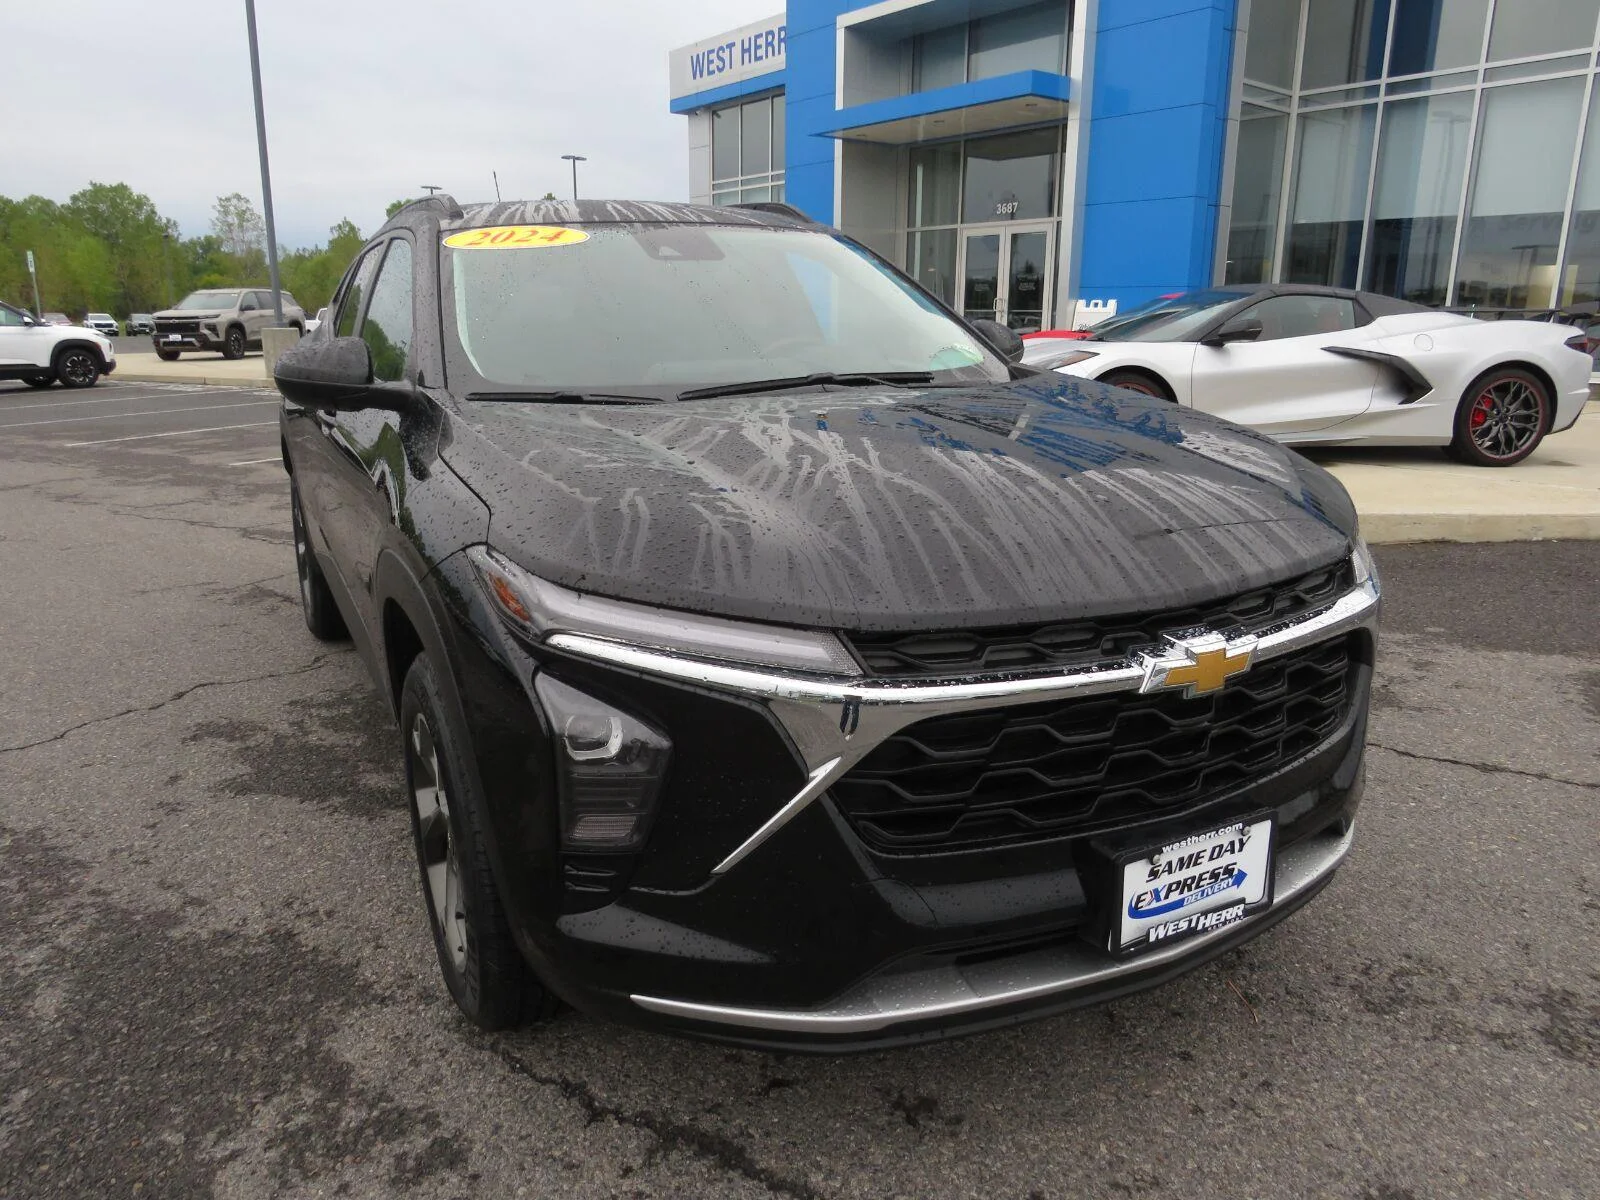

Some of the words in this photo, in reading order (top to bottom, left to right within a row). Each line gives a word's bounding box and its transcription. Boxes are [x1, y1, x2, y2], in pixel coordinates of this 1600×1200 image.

[690, 41, 736, 80] WEST
[740, 25, 787, 66] HERR
[996, 202, 1019, 215] 3687
[464, 229, 567, 247] 2024
[1161, 822, 1243, 853] westherr.com
[1146, 849, 1207, 883] SAME
[1207, 835, 1251, 862] DAY
[1134, 862, 1237, 911] EXPRESS
[1183, 876, 1235, 906] DELIVERY
